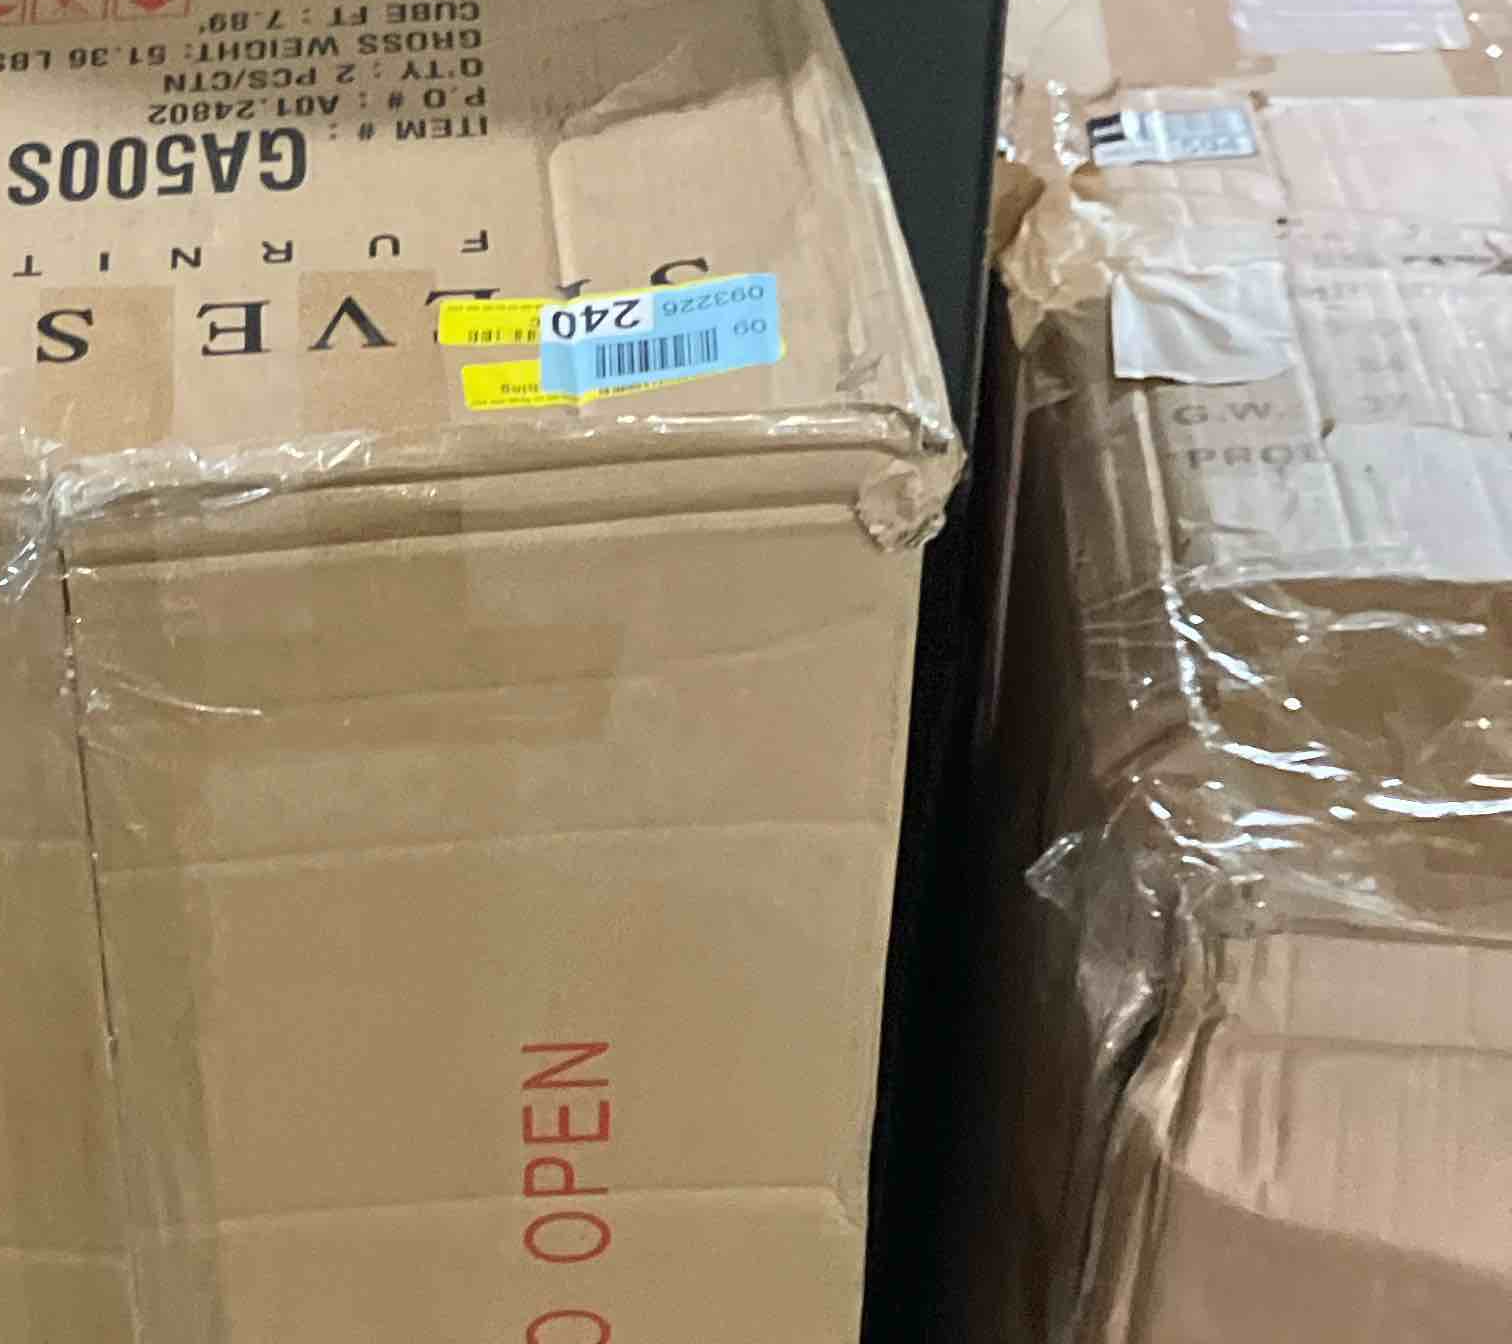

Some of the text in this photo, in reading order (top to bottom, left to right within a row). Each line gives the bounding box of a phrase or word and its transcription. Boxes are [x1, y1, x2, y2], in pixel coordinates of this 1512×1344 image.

[327, 3, 367, 26] FT
[384, 0, 480, 25] CUBE
[183, 33, 337, 64] WEIGHT:
[355, 27, 482, 55] GROSS
[67, 42, 166, 70] 51.36
[399, 55, 483, 82] Q'TY
[162, 65, 316, 93] PCS/CTN
[333, 61, 355, 84] 2
[145, 90, 339, 124] A01.24802
[394, 114, 487, 140] ITEM
[5, 125, 306, 206] GA500S
[660, 283, 764, 316] 093226
[550, 297, 640, 339] 240
[520, 1040, 612, 1265] OPEN
